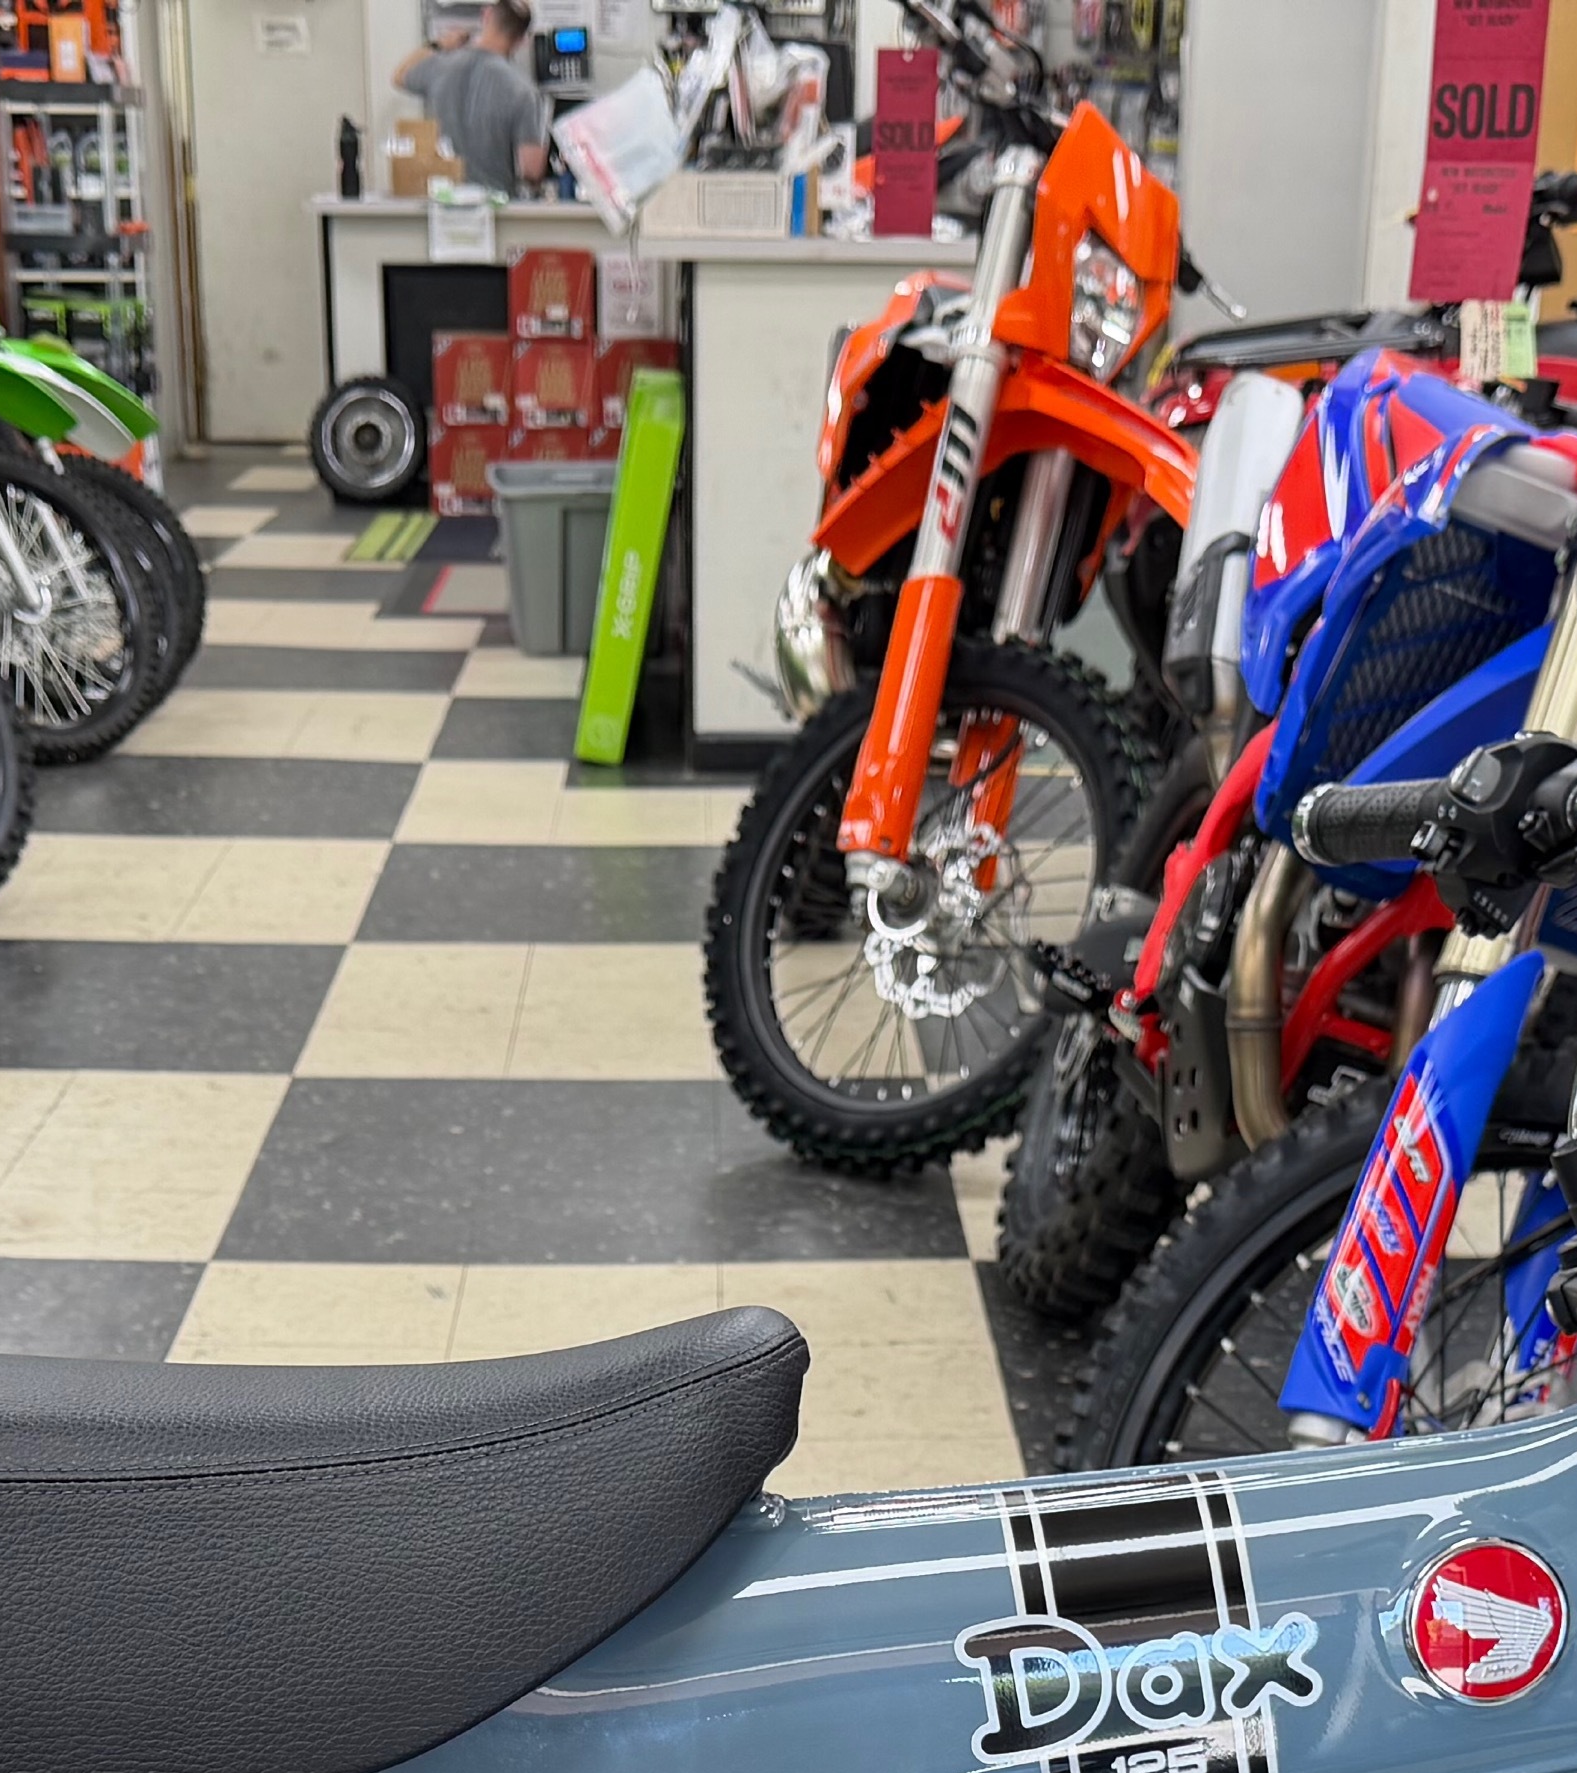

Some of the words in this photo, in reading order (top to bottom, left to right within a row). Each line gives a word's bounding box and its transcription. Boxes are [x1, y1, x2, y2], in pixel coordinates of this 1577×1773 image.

[879, 120, 934, 152] SOLD
[1434, 83, 1536, 140] SOLD
[954, 1612, 1322, 1765] Dax
